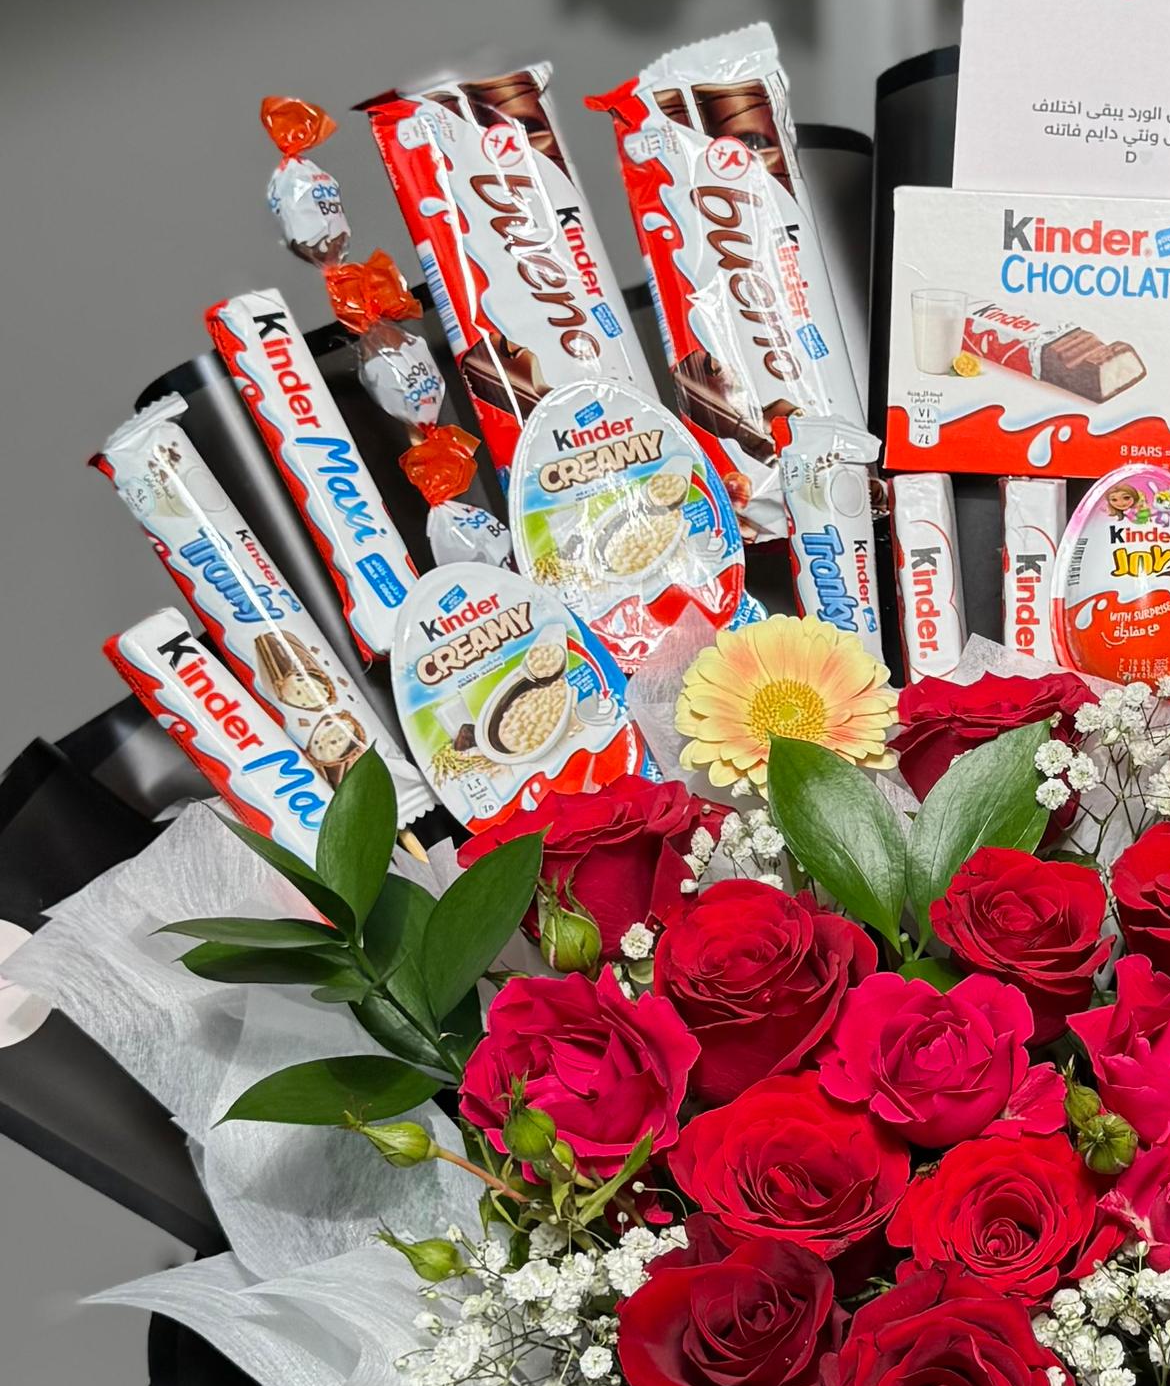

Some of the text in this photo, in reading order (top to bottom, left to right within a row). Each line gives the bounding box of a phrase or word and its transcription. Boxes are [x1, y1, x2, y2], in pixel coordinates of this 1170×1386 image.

[1032, 99, 1082, 115] اختلاف
[1044, 123, 1082, 138] فاتنه
[1085, 126, 1119, 143] دايم
[1086, 103, 1124, 121] يبقى
[1127, 106, 1162, 123] الورد
[1122, 128, 1160, 147] ونتي
[1124, 151, 1137, 164] D
[556, 205, 604, 298] Kinder
[1003, 209, 1149, 256] Kinder
[689, 184, 803, 382] bueno
[772, 223, 811, 319] Kinder
[973, 303, 1040, 332] Kinder
[253, 311, 323, 430] Kinder
[538, 428, 664, 494] CREAMY
[552, 416, 634, 453] Kinder
[1120, 444, 1129, 456] 8
[1130, 445, 1163, 458] BARS
[294, 435, 389, 546] Maxi
[235, 529, 281, 588] Kinder
[800, 524, 860, 632] Tronky
[853, 539, 872, 605] Kinder
[419, 592, 502, 643] Kinder
[910, 546, 942, 652] Kinder
[1014, 554, 1048, 658] Kinder
[1109, 611, 1132, 623] WITH
[415, 601, 535, 687] CREAMY
[1147, 623, 1161, 638] مع
[157, 630, 265, 752] Kinder
[241, 748, 331, 831] Ma
